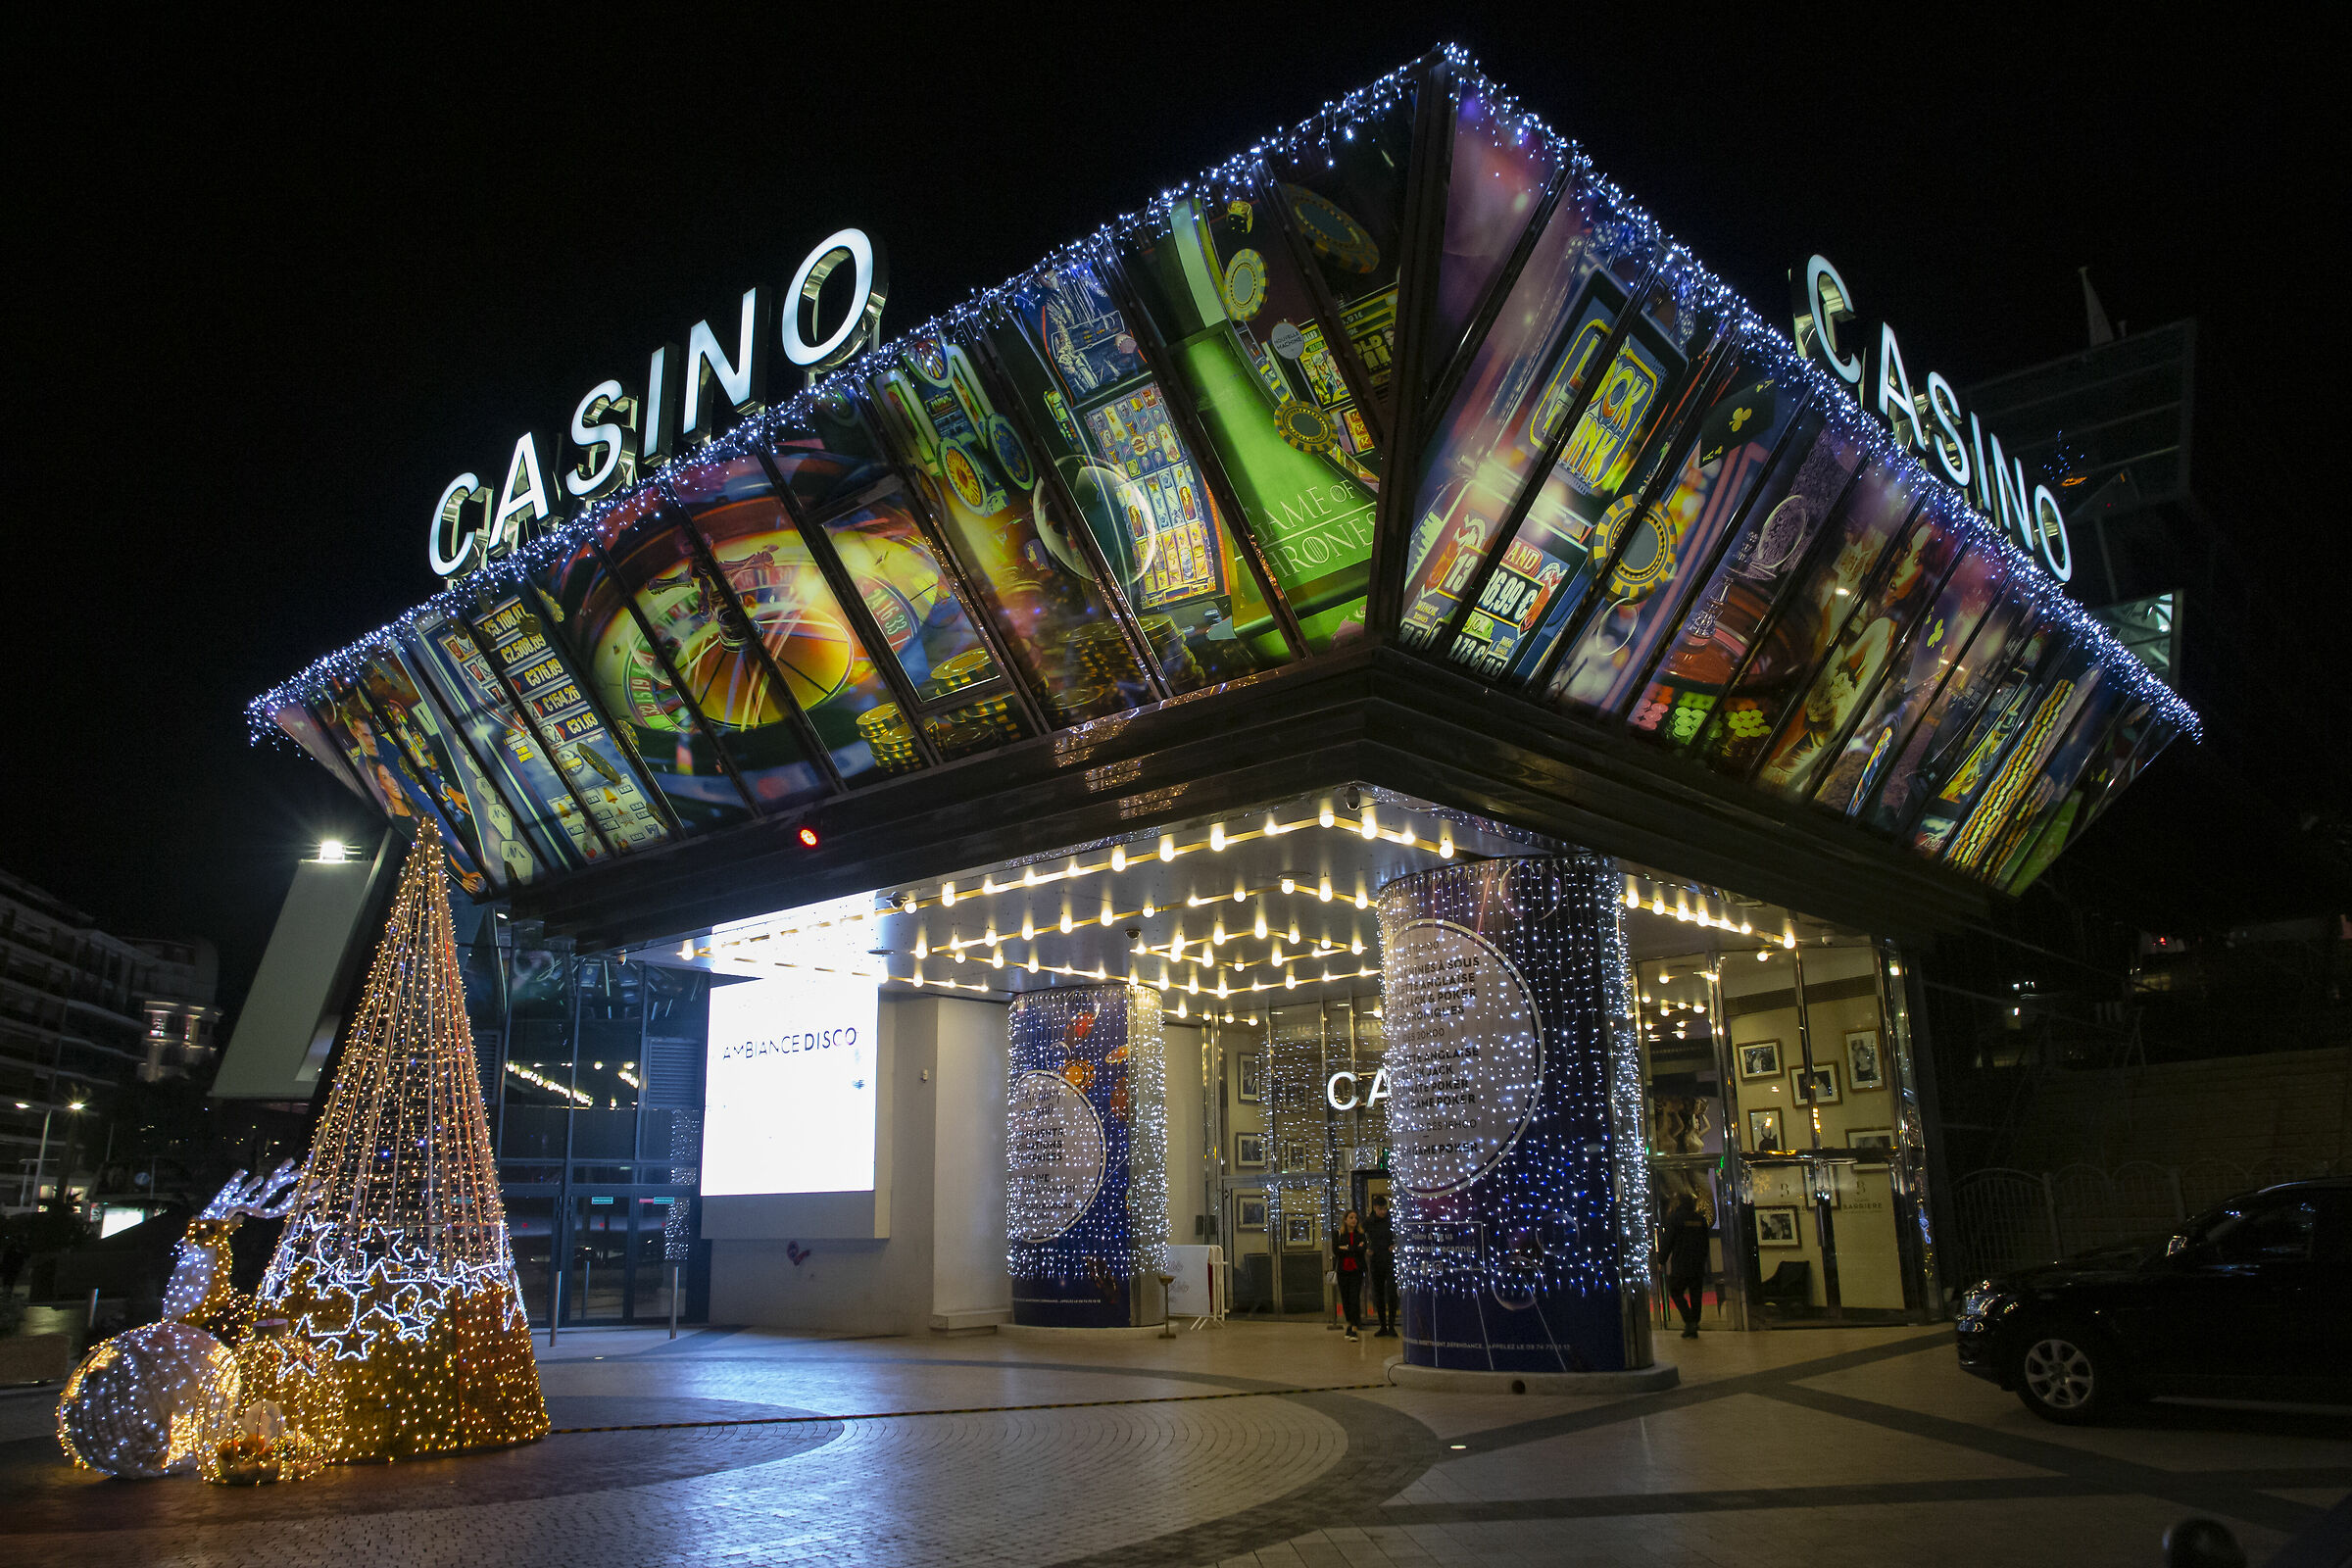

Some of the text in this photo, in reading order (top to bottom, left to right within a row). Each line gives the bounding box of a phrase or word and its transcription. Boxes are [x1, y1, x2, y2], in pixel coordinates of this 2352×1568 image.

[429, 227, 874, 576] CASINO
[1807, 254, 2073, 583] CASINO
[1330, 479, 1355, 503] OF
[1269, 511, 1377, 577] HRONES
[874, 600, 900, 619] 16
[884, 615, 907, 635] 33
[1447, 956, 1481, 971] SOUS
[1419, 972, 1476, 992] ANGLAISE
[1438, 988, 1478, 1003] POKER
[722, 1026, 858, 1060] AMBIANCE DISCO
[1423, 1047, 1480, 1062] ANGLAISE
[1427, 1064, 1453, 1077] JACK
[1431, 1079, 1469, 1093] POKER
[1436, 1094, 1477, 1107] POKER
[1438, 1141, 1479, 1154] POKER
